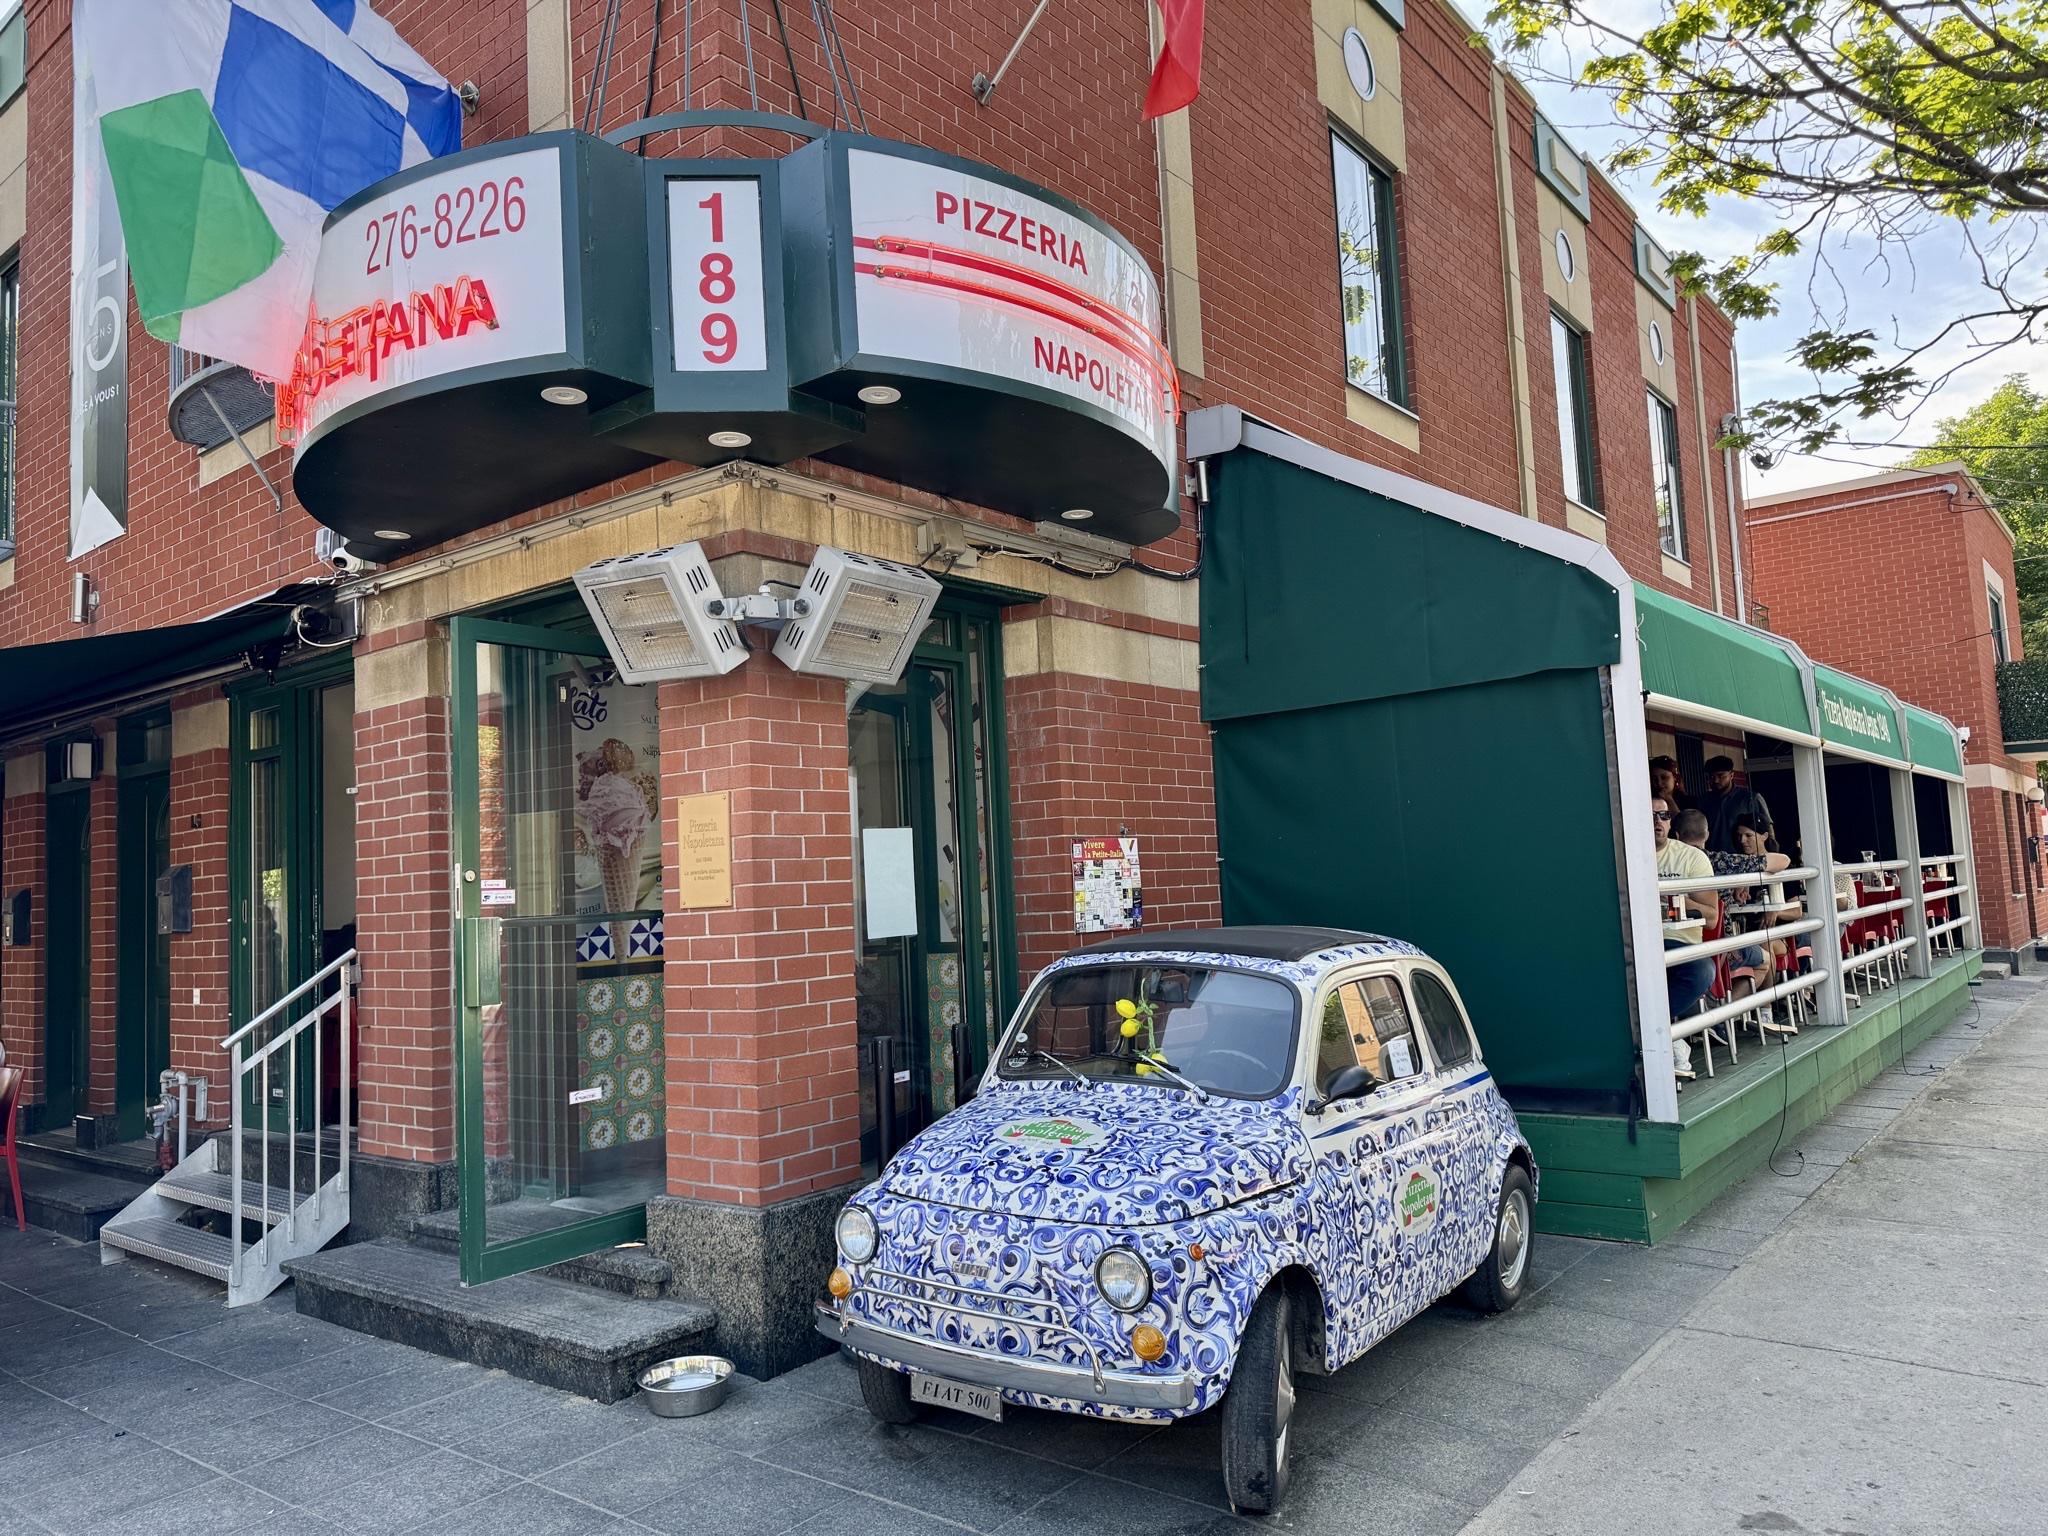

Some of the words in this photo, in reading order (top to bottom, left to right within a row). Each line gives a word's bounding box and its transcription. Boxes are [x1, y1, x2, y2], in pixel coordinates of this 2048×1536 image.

[366, 176, 526, 275] 276-8226
[936, 191, 1088, 276] PIZZERIA
[1083, 840, 1105, 849] Vivere
[922, 1381, 963, 1403] FIAT
[967, 1392, 991, 1411] 500
